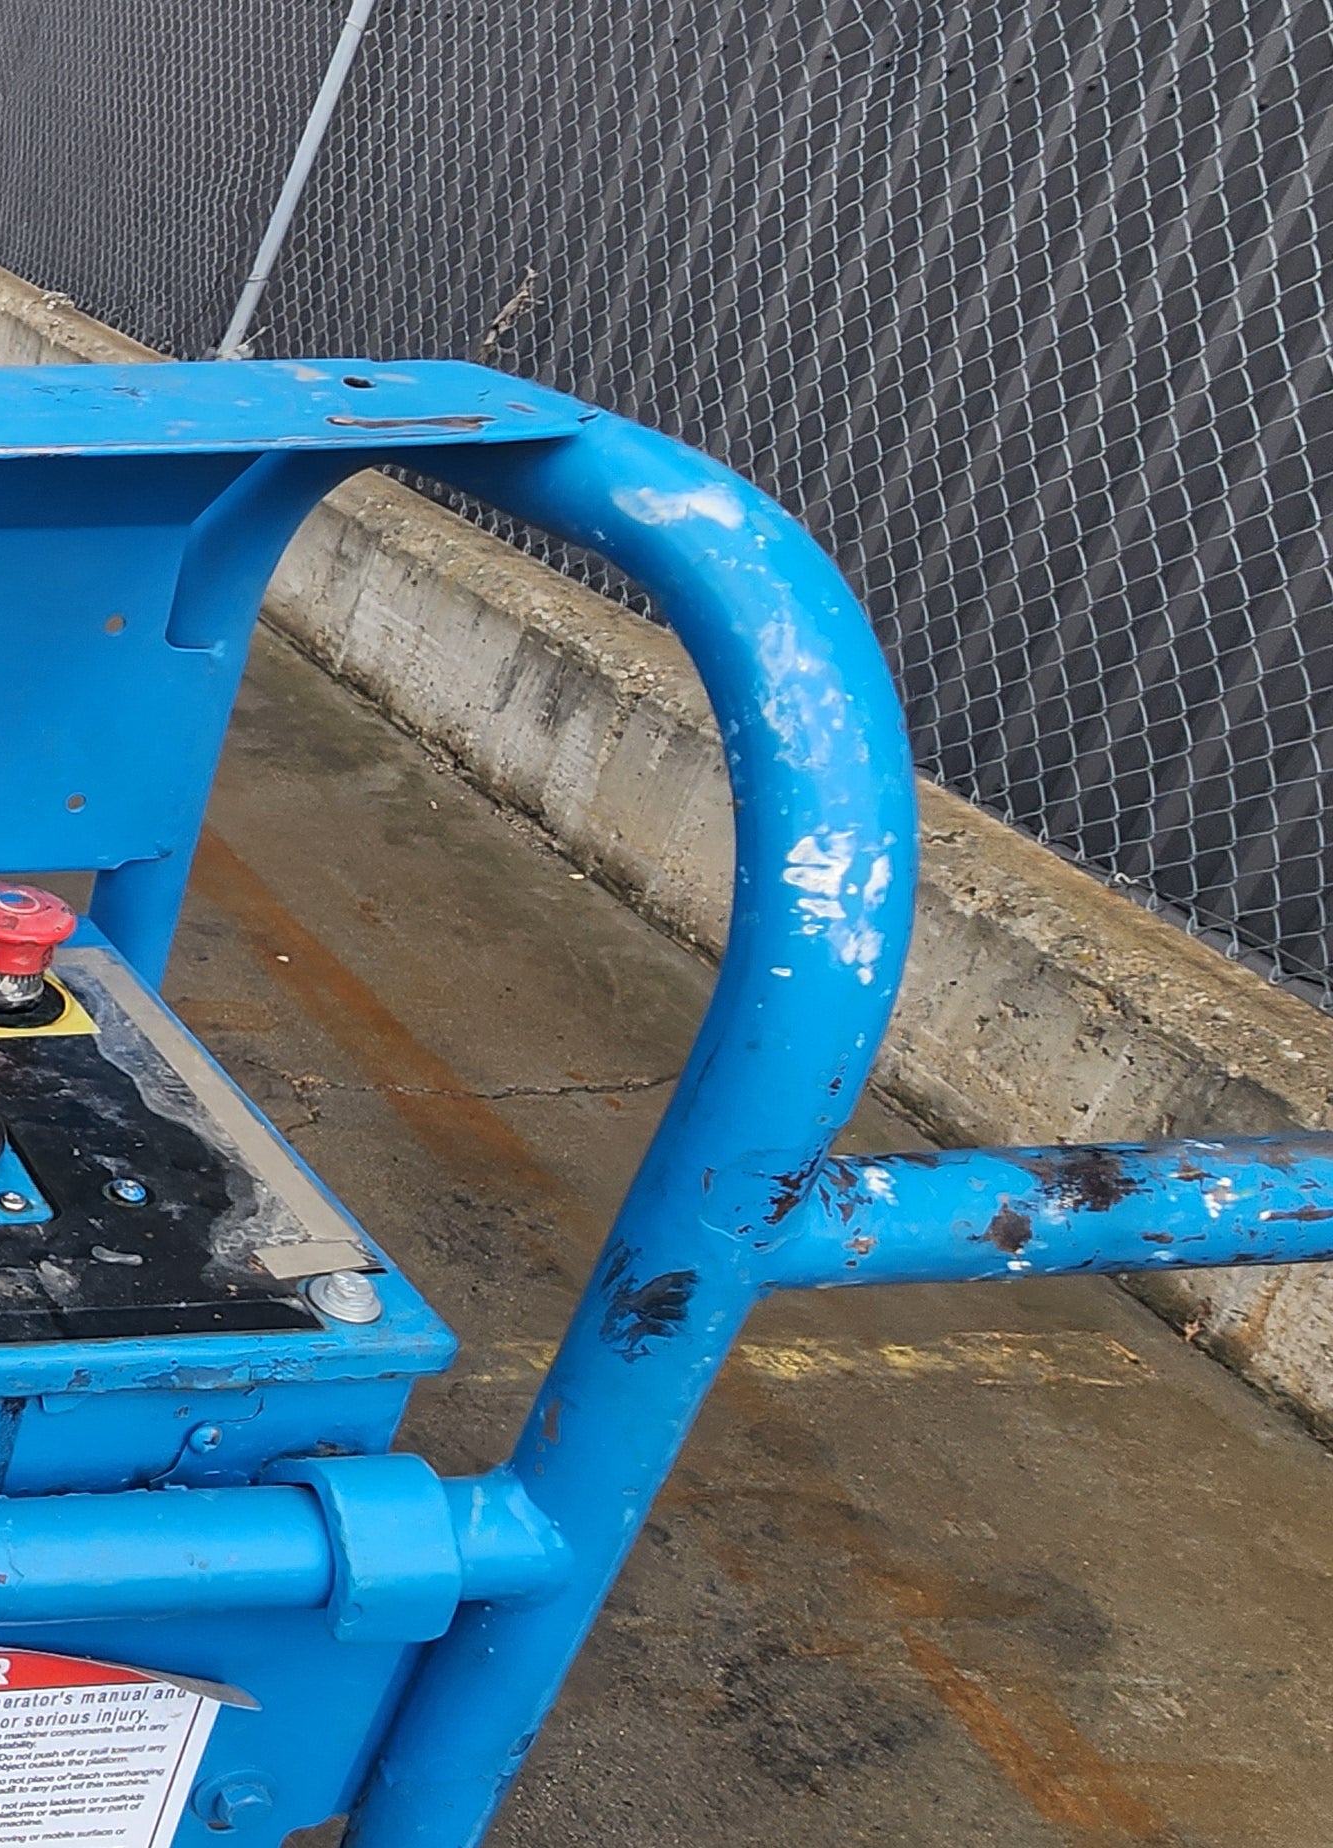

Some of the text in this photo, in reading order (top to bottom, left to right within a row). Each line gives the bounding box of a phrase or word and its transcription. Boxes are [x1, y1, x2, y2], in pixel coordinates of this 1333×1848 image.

[81, 1686, 149, 1704] manual
[0, 1718, 19, 1728] or
[24, 1712, 90, 1727] serious
[96, 1707, 148, 1725] injury.
